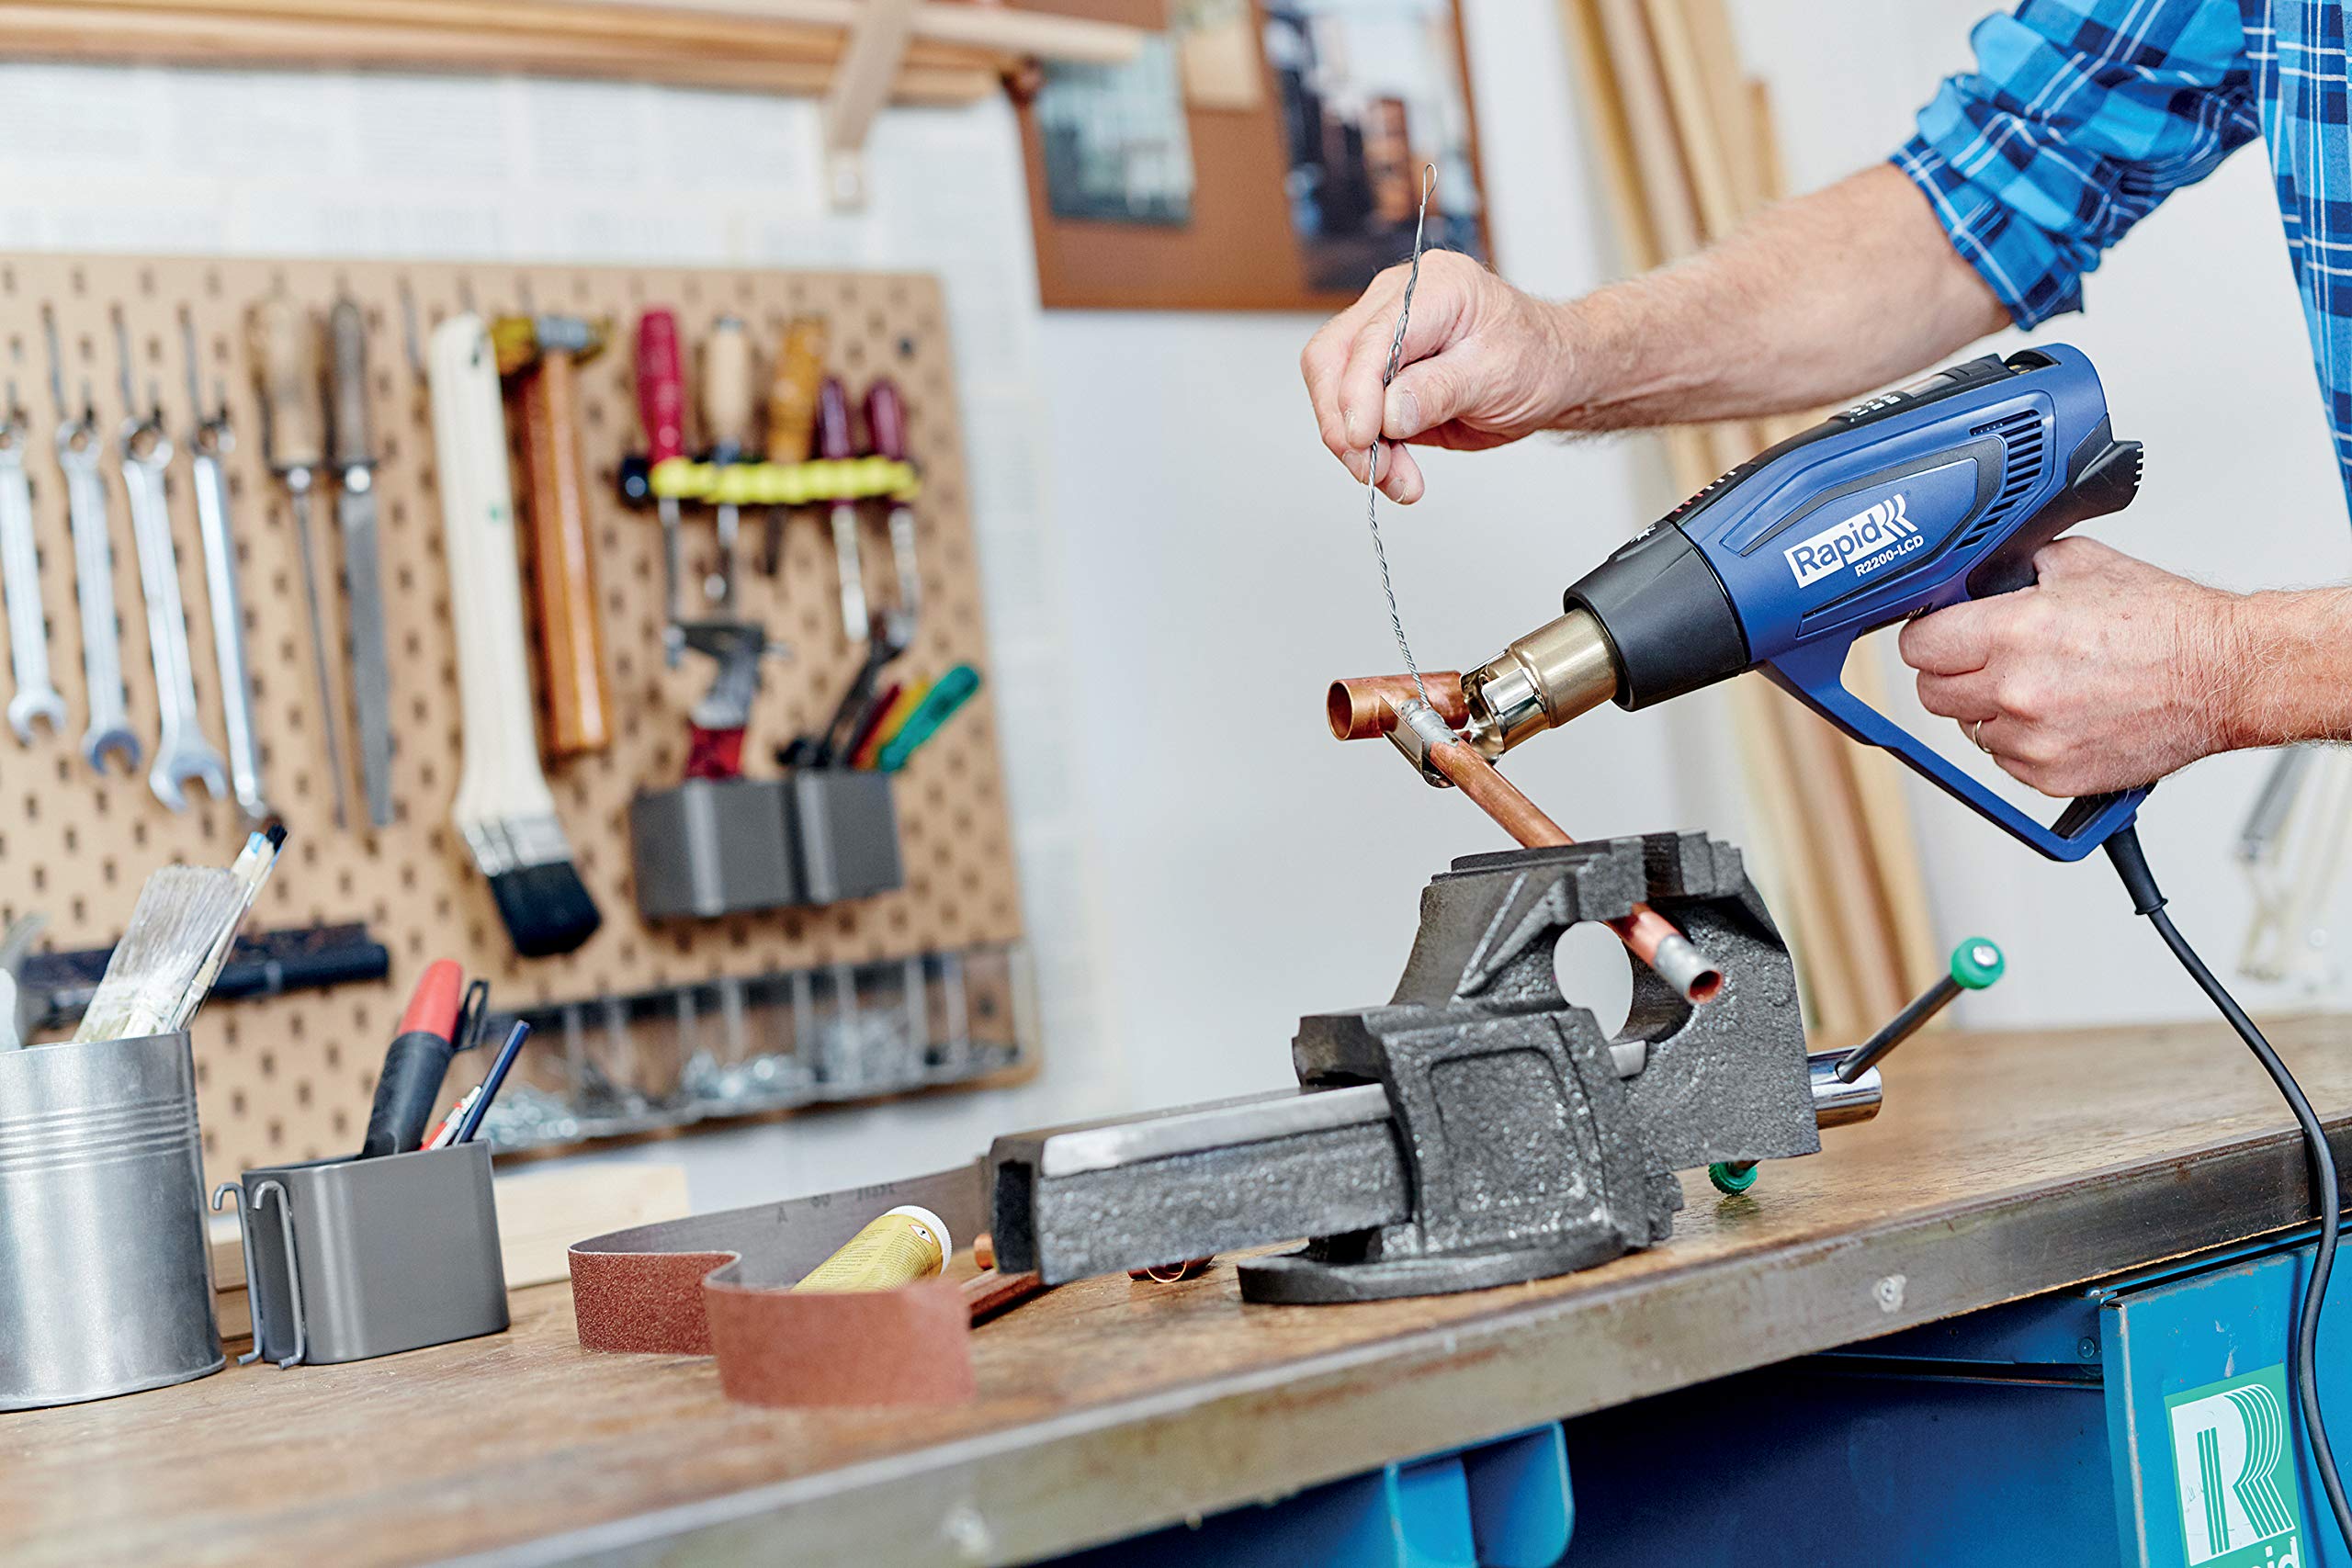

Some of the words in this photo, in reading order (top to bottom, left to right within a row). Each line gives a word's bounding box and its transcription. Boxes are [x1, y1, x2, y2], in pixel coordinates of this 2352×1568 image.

[1792, 513, 1883, 577] Rapid
[1854, 535, 1924, 578] R2200-LCD
[2170, 1383, 2296, 1567] R
